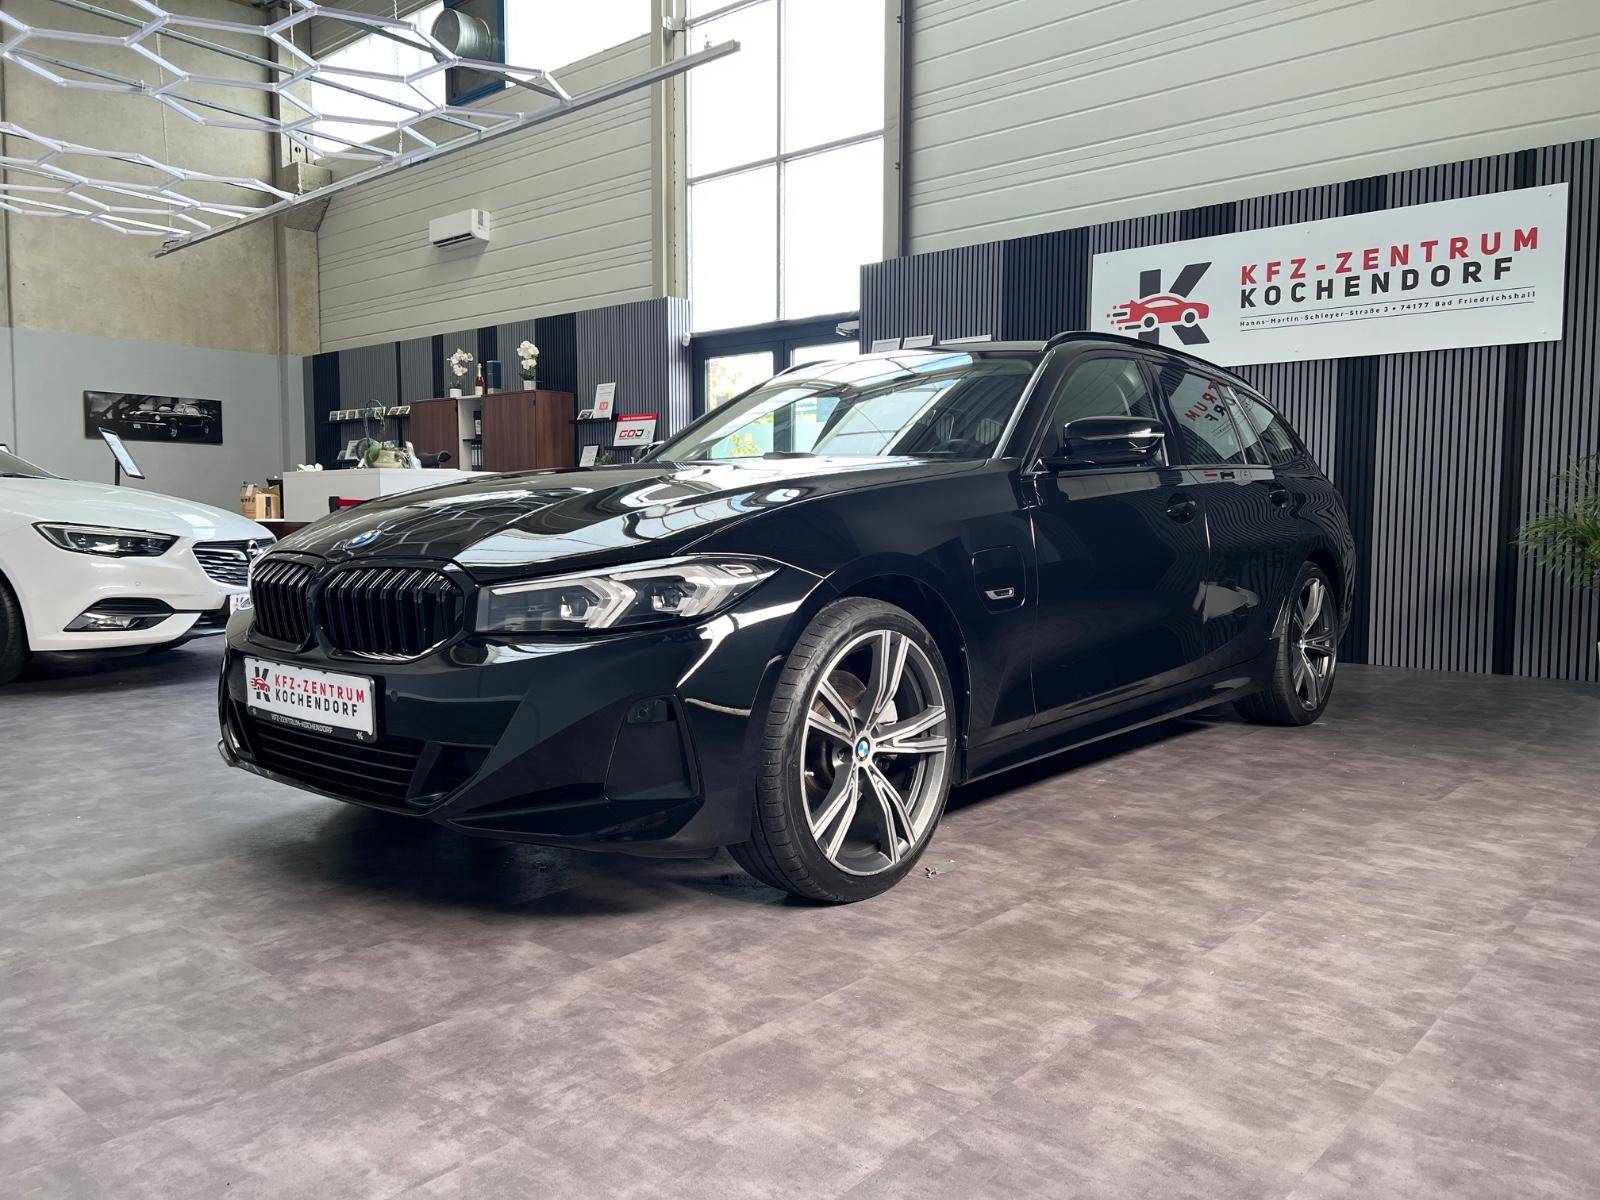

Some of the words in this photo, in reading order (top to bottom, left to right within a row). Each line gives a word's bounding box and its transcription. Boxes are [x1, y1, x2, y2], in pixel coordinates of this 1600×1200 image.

[1240, 226, 1538, 286] KFZ-ZENTRUM
[1240, 256, 1513, 309] KOCHENDORF
[1400, 302, 1430, 312] 74177
[1434, 299, 1453, 307] Bad
[1457, 290, 1536, 305] Friedrichshall
[274, 673, 365, 703] KFZ-ZENTRUM
[275, 688, 358, 717] KOCHENDORF
